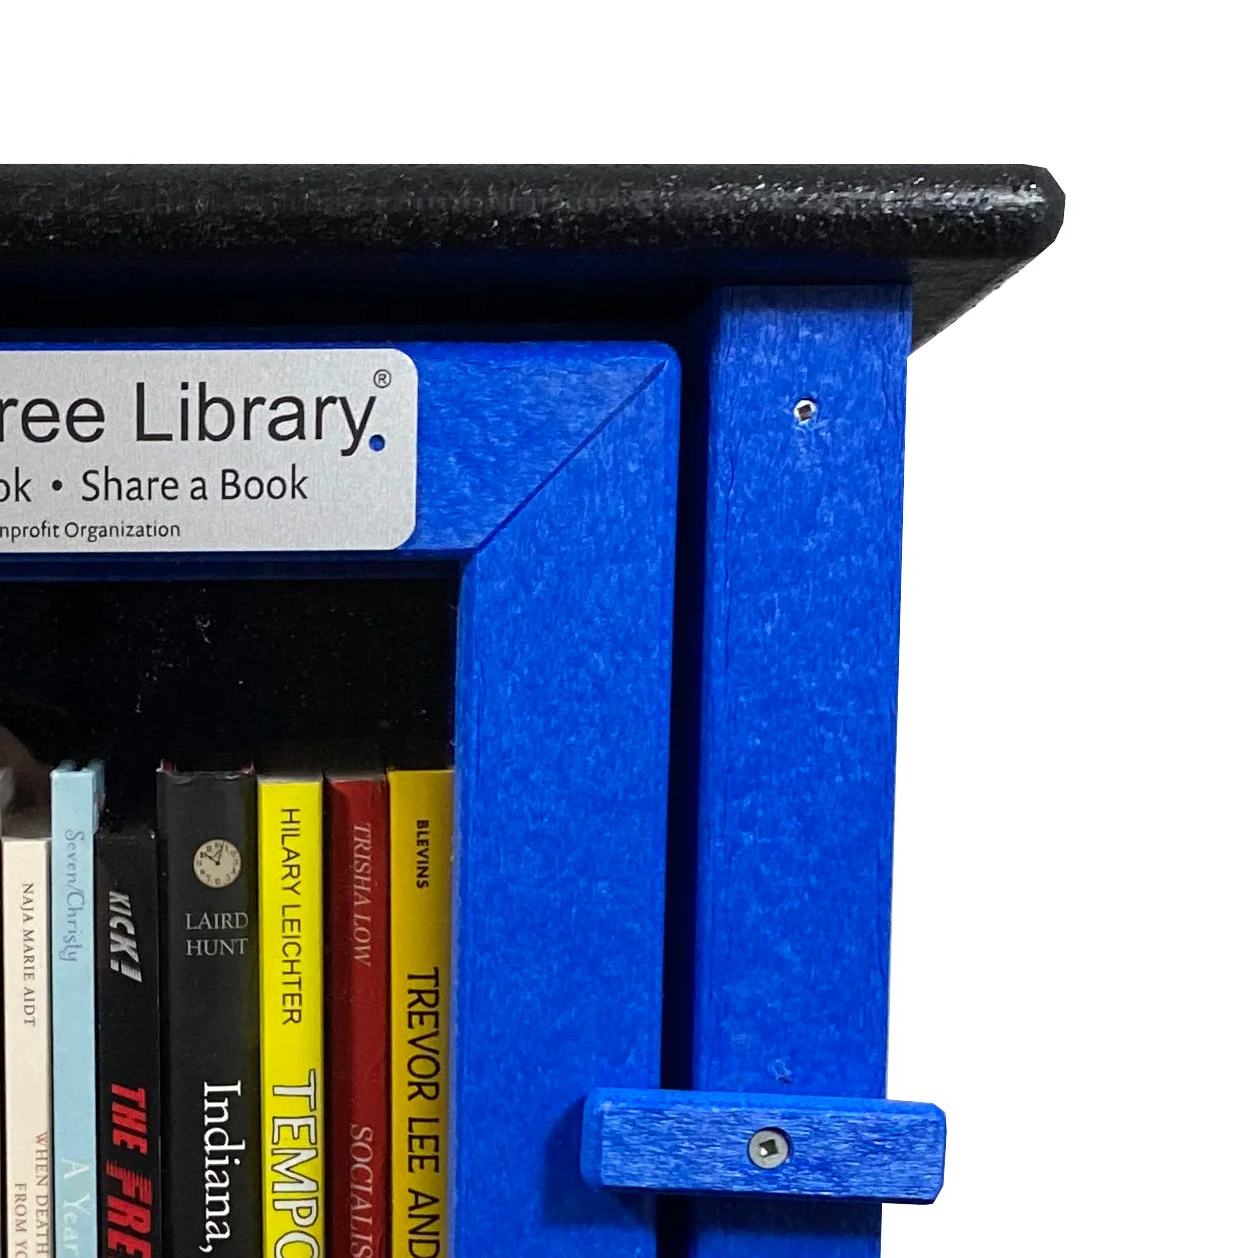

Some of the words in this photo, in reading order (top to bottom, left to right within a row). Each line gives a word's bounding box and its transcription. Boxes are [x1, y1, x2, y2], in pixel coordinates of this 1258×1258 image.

[135, 381, 377, 456] Library
[80, 467, 181, 503] Share
[190, 476, 210, 501] a
[221, 468, 309, 502] Book
[64, 520, 181, 543] Organization
[280, 807, 301, 895] HILARY
[352, 822, 372, 906] TRISHA
[416, 818, 430, 889] BLEVINS
[22, 882, 35, 926] NAJA
[185, 912, 249, 931] LAIRD
[22, 929, 36, 981] MARIE
[108, 890, 143, 984] KICK!
[186, 937, 249, 957] HUNT
[281, 904, 302, 1026] LEICHTER
[353, 913, 372, 968] LOW
[23, 986, 36, 1027] AIDT
[407, 965, 440, 1102] TREVOR
[110, 1082, 148, 1156] THE
[407, 1116, 440, 1173] LEE
[35, 1131, 49, 1187] WHEN
[61, 1157, 90, 1179] A
[198, 1080, 246, 1254] Indiana,
[14, 1182, 27, 1236] FROM
[35, 1192, 50, 1254] DEATH
[61, 1193, 91, 1256] Year
